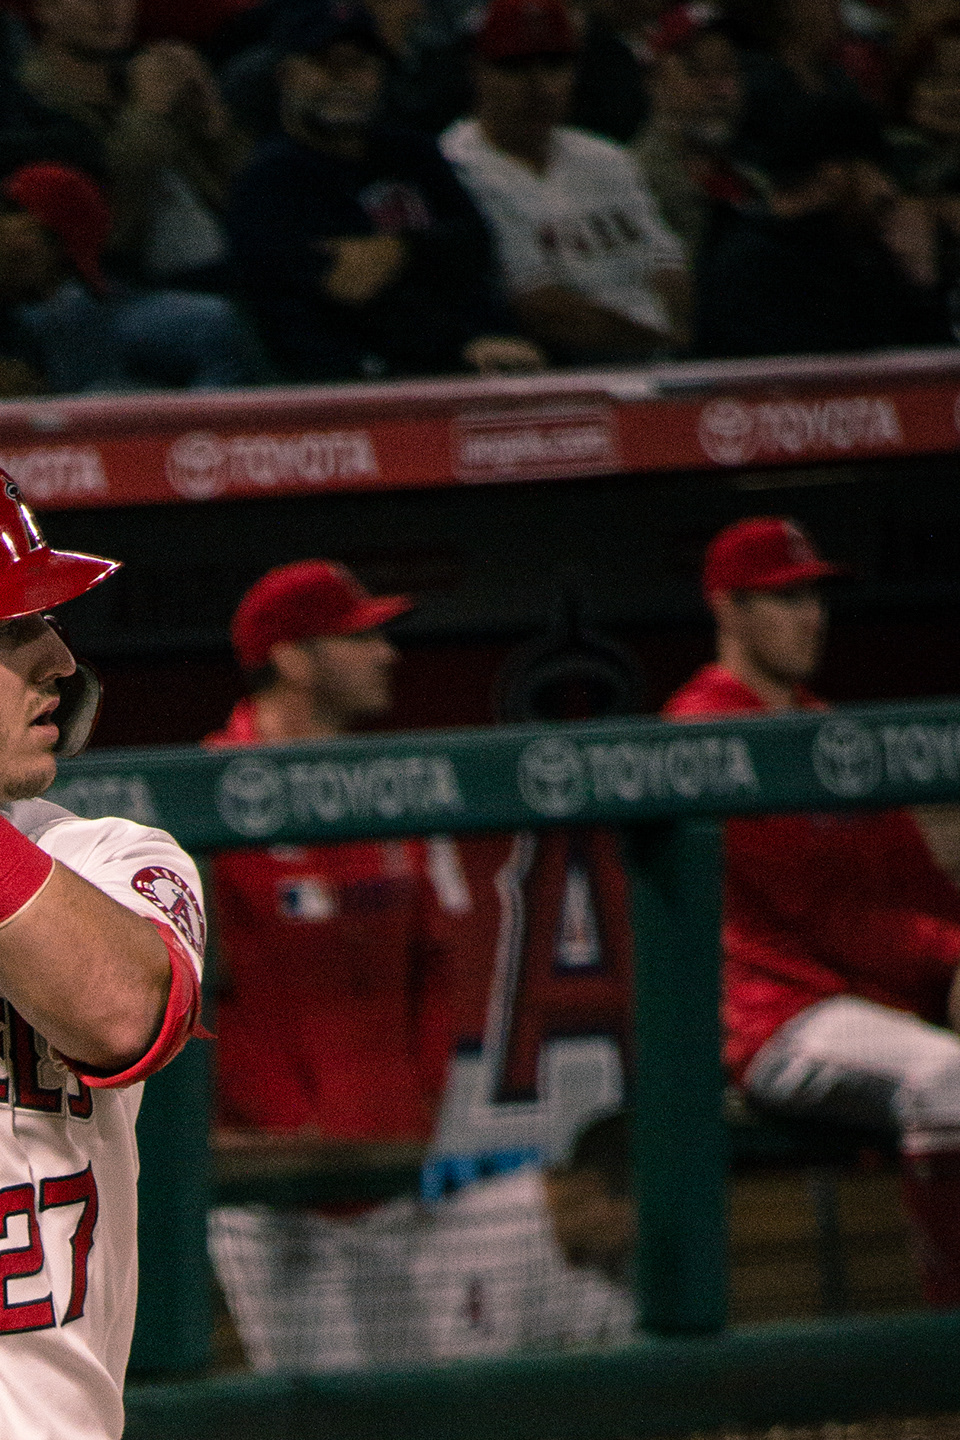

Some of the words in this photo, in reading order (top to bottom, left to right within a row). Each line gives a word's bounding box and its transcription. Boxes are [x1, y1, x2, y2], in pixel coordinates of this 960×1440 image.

[755, 398, 905, 454] TOYOTA
[230, 429, 381, 487] TOYOTA
[287, 754, 467, 823] TOYOTA
[584, 735, 760, 801] TOYOTA
